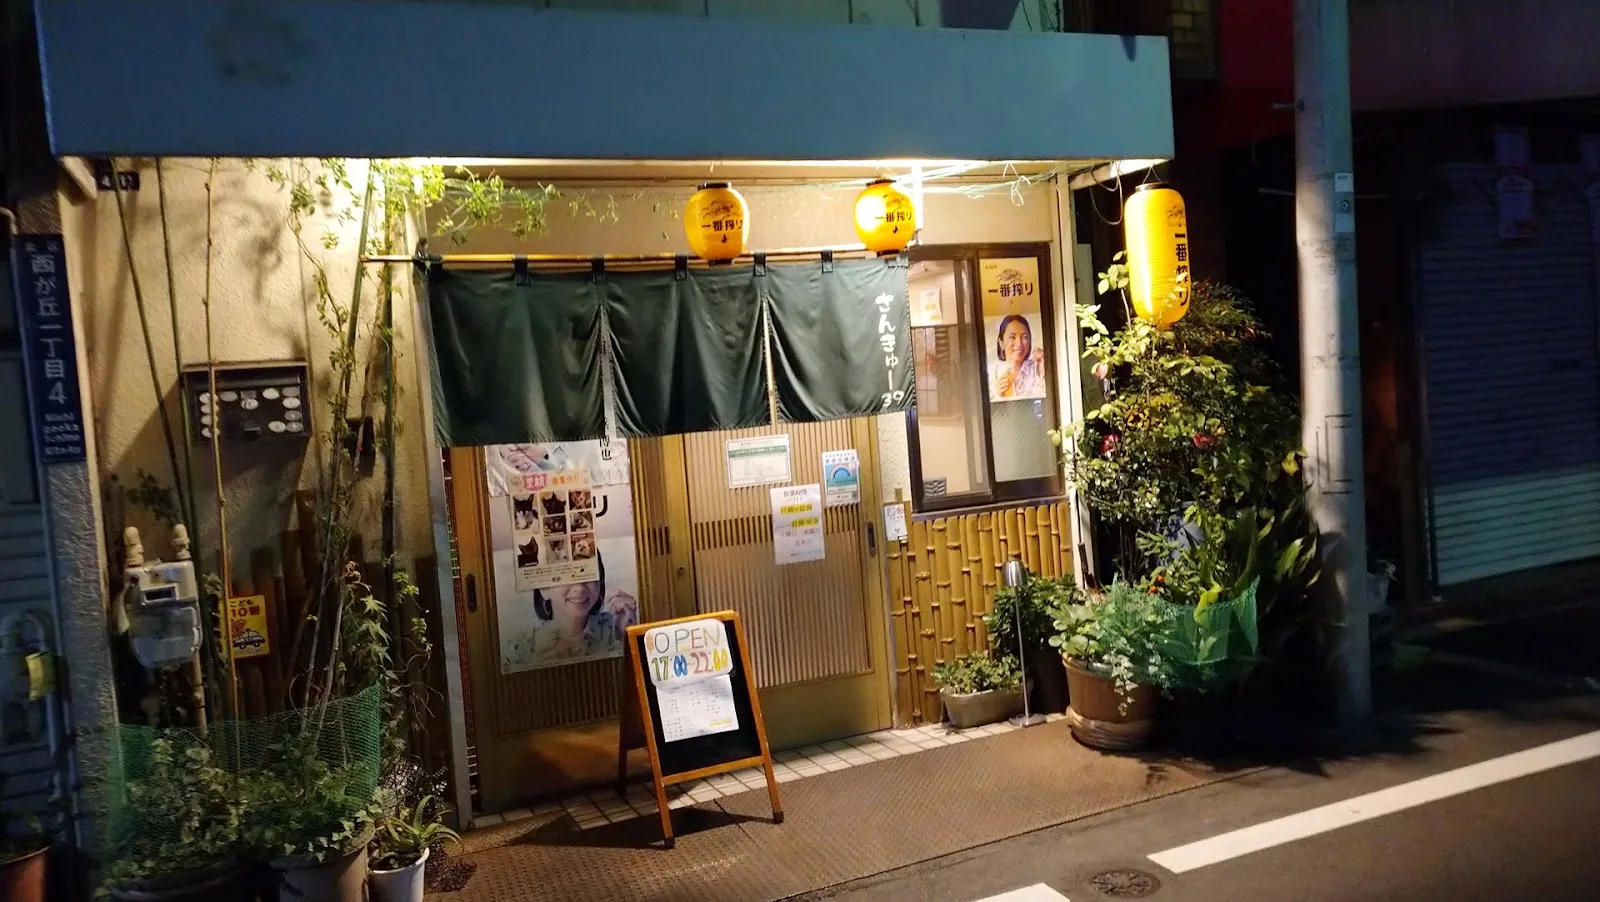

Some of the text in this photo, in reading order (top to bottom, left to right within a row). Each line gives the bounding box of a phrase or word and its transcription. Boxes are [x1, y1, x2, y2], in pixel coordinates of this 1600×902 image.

[988, 282, 1034, 297] 一番搾り
[654, 623, 721, 654] OPEN
